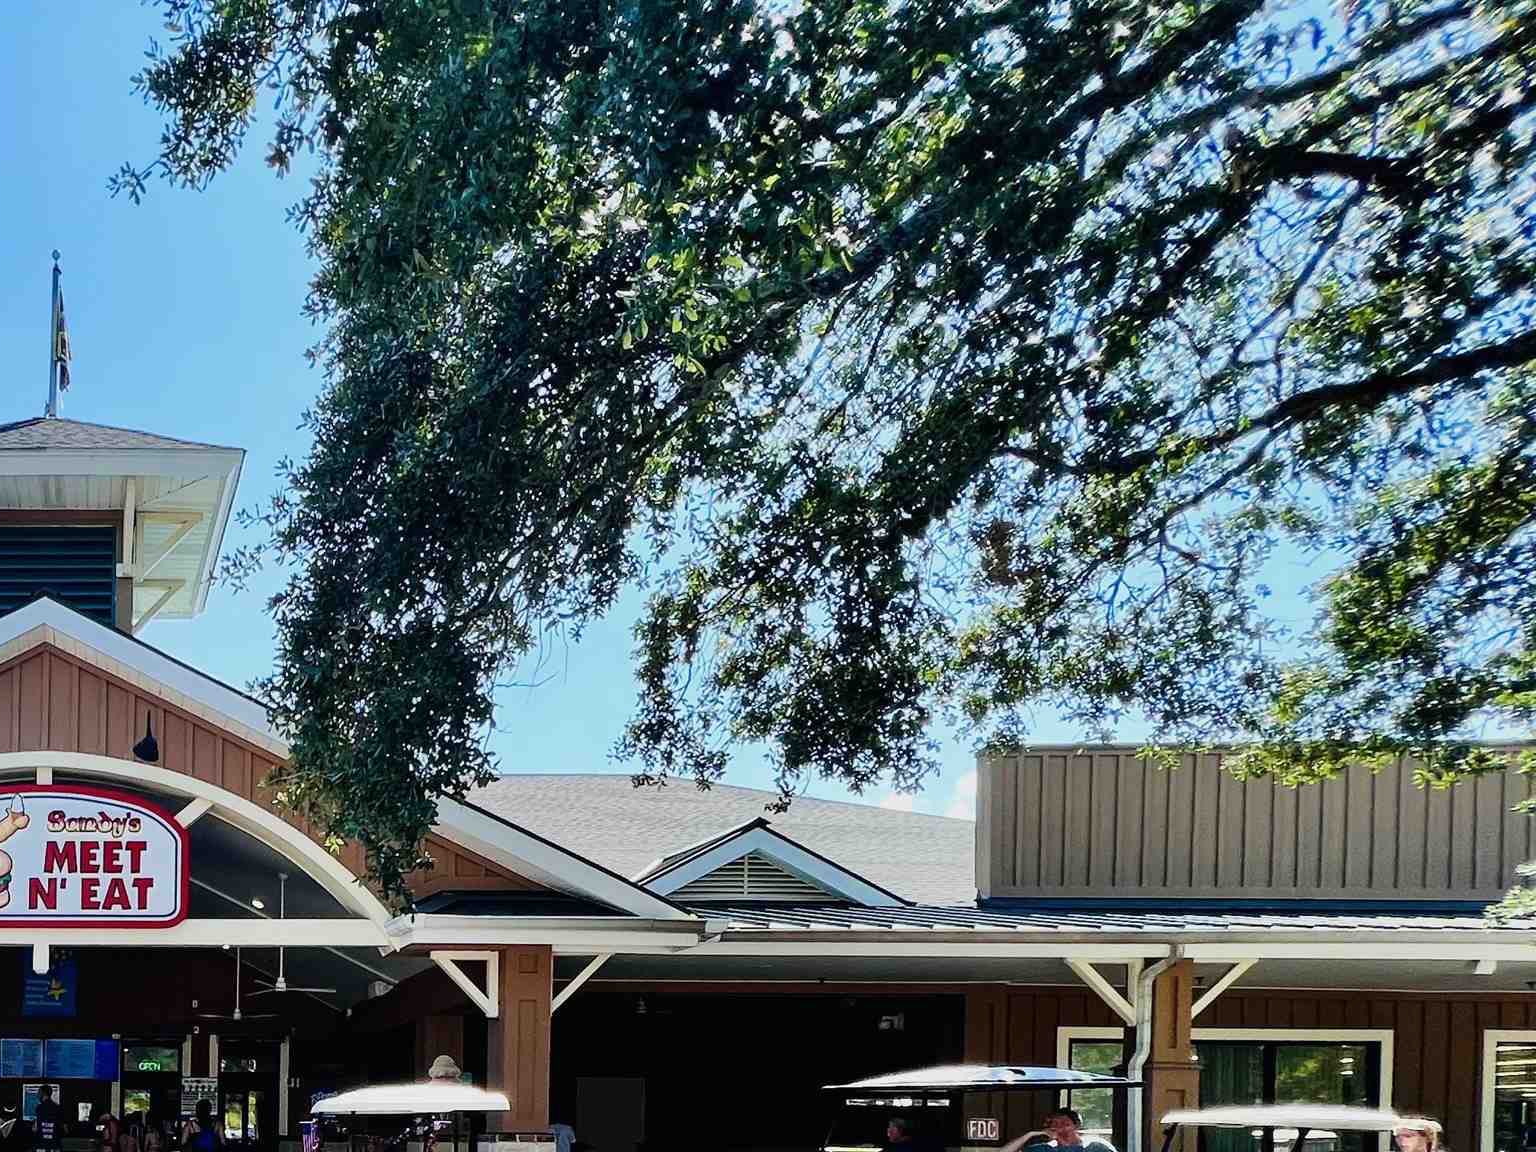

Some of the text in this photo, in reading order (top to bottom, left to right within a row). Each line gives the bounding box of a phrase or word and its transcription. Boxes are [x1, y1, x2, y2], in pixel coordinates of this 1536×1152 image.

[47, 810, 141, 838] Sandy's
[44, 841, 147, 873] MEET
[28, 878, 153, 910] N' EAT
[139, 1062, 161, 1071] OPEN
[969, 1120, 997, 1138] FDC
